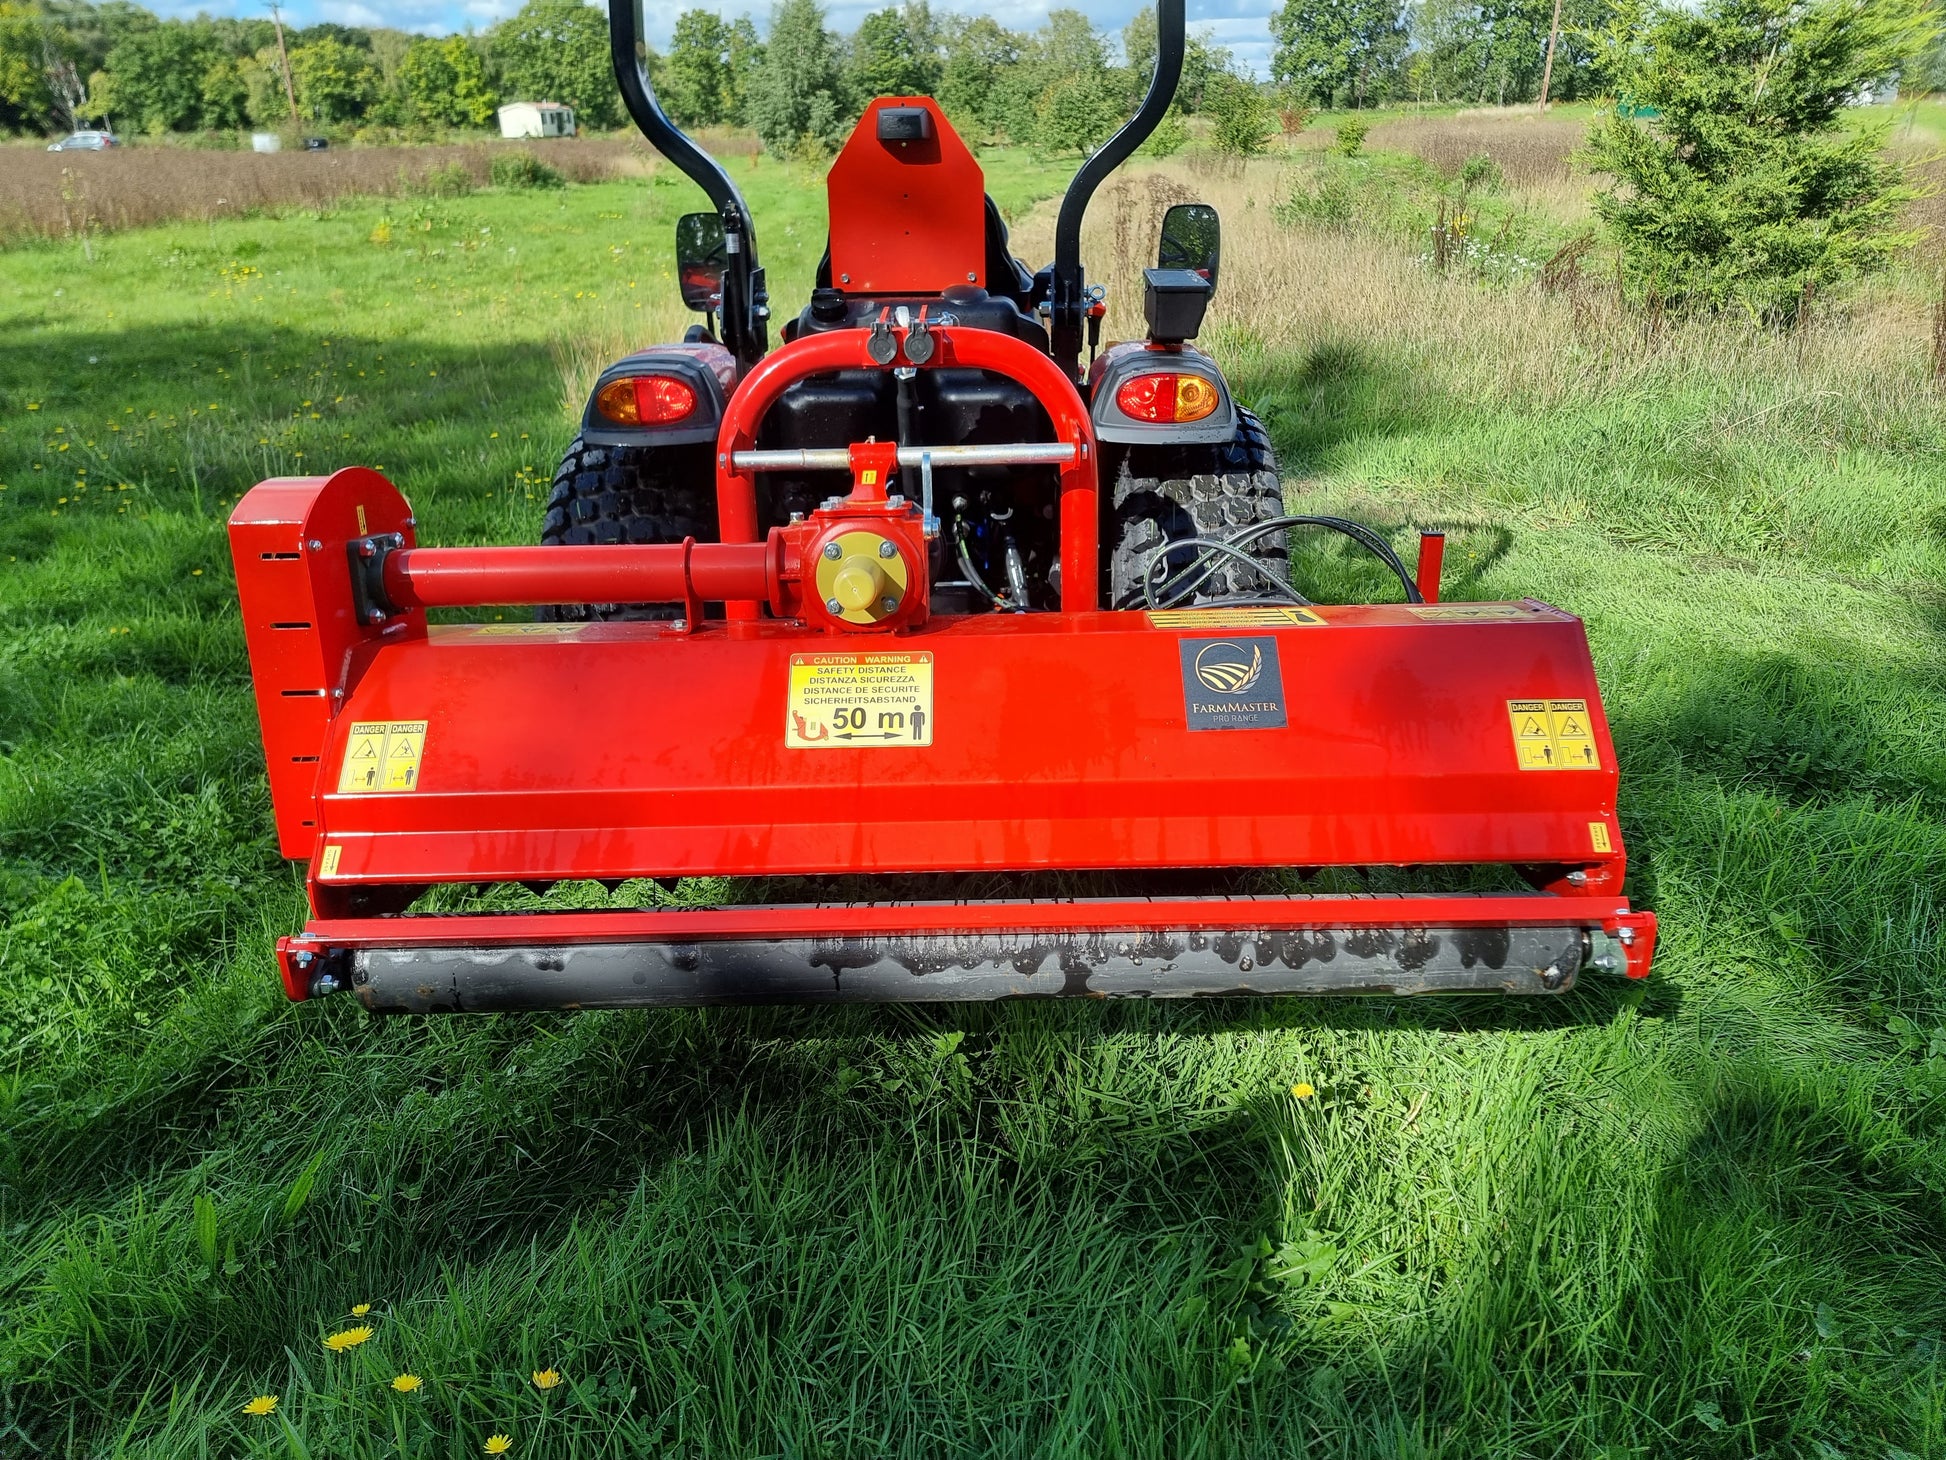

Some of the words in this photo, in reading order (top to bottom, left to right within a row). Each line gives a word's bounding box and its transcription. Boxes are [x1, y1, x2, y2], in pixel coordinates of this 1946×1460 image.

[814, 656, 857, 665] CAUTION
[865, 655, 911, 664] WARNING
[817, 667, 855, 675] SAFETY
[858, 666, 907, 674] DISTANCE
[809, 677, 858, 685] DISTANZA
[860, 675, 915, 684] SICUREZZA
[803, 687, 852, 695] DISTANCE
[855, 686, 869, 694] DE
[871, 685, 920, 693] SECURITE
[804, 696, 917, 705] SICHERHEITSABSTAND
[1512, 703, 1545, 712] DANGER
[1551, 703, 1584, 711] DANGER
[832, 707, 867, 730] 50
[878, 711, 905, 729] m
[1231, 714, 1258, 722] RANGE
[354, 725, 386, 734] DANGER
[392, 725, 423, 733] DANGER
